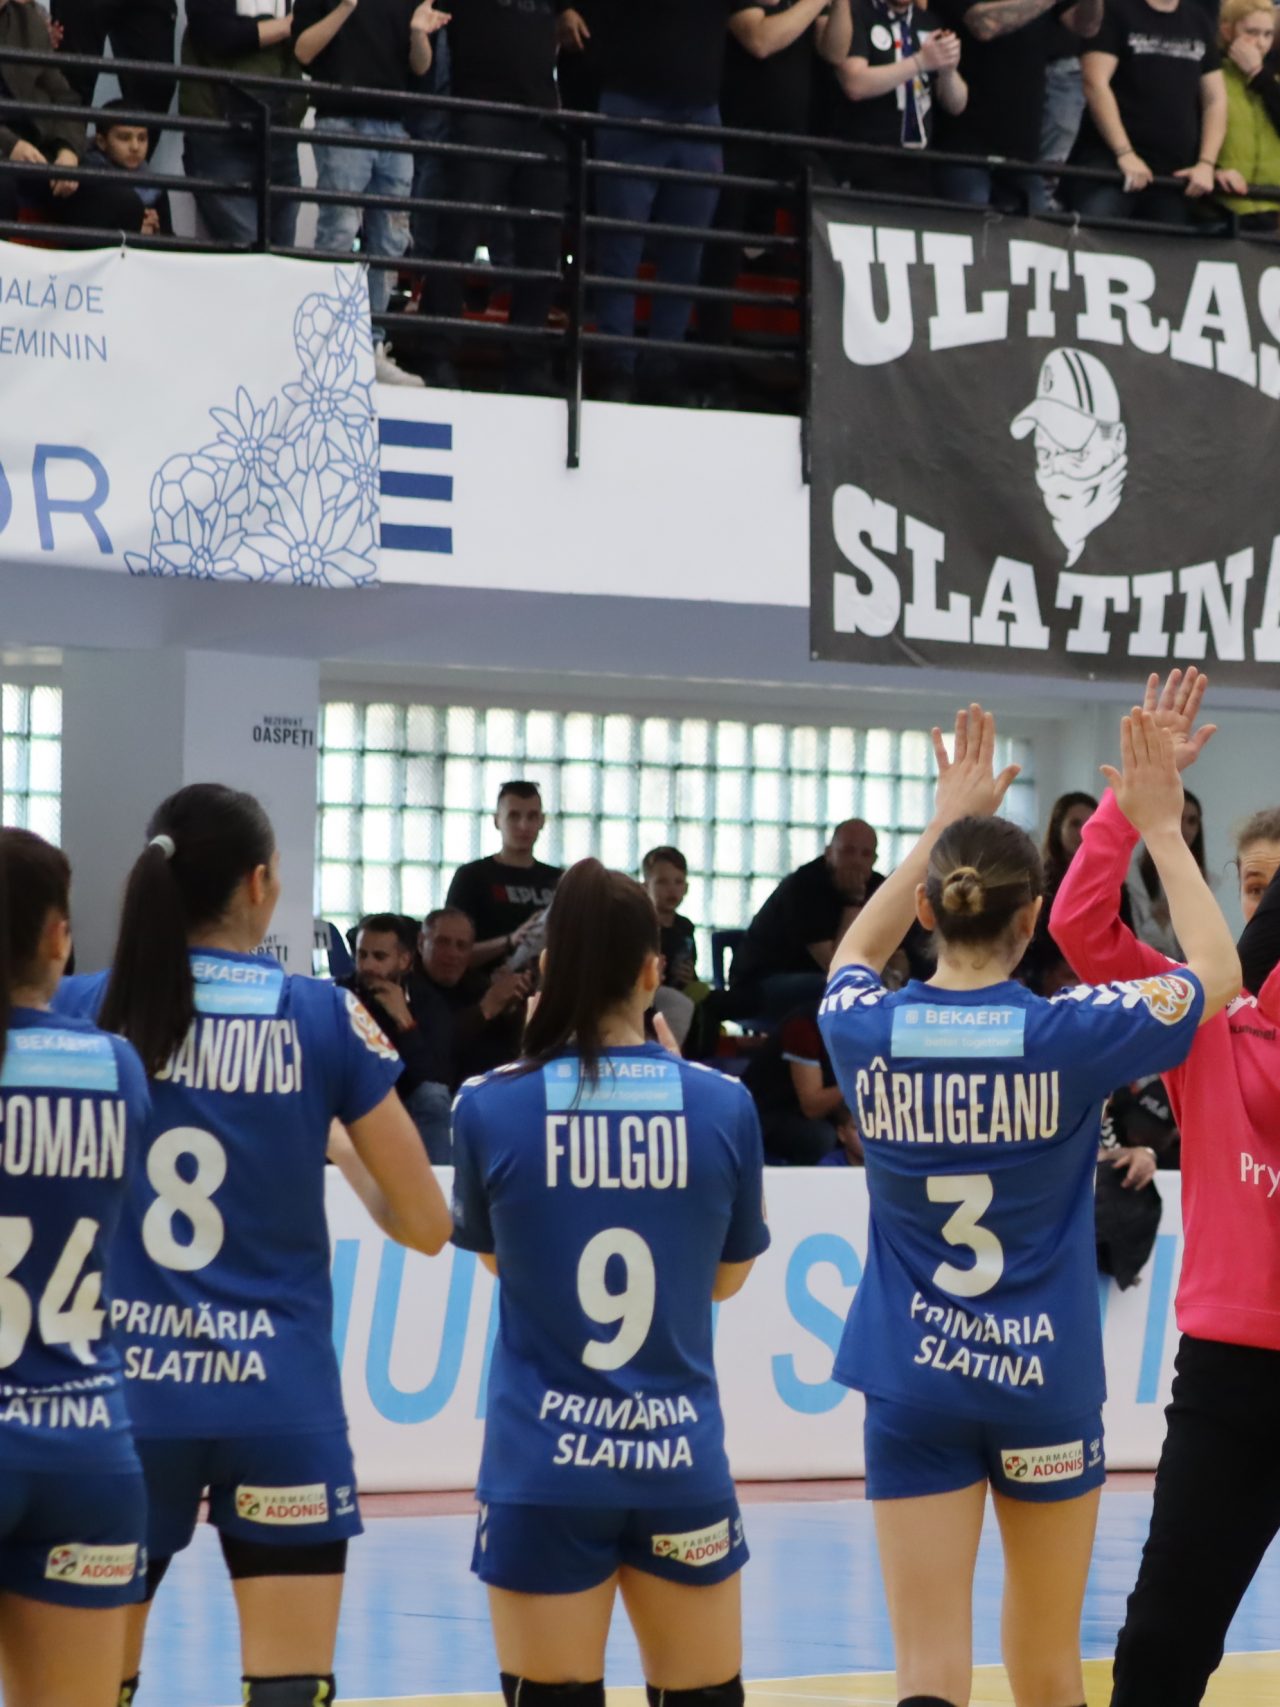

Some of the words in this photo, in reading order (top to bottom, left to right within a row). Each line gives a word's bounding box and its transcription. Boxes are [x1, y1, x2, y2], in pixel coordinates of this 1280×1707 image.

[0, 274, 57, 310] ALĂ
[64, 283, 104, 314] DE
[0, 443, 114, 555] R
[191, 960, 271, 985] EKAERT
[925, 1009, 1013, 1026] BEKAERT
[855, 1056, 1060, 1145] CÂRLIGEANU
[0, 1094, 126, 1180] OMAN
[546, 1115, 688, 1189] FULGOI
[142, 1126, 228, 1272] 8
[926, 1174, 1004, 1298] 3
[110, 1299, 275, 1340] PRIMĂRIA
[577, 1227, 656, 1371] 9
[910, 1291, 1054, 1345] PRIMĂRIA
[124, 1345, 266, 1384] SLATINA
[914, 1335, 1044, 1387] SLATINA
[0, 1395, 112, 1430] ATINA
[539, 1390, 698, 1431] PRIMĂRIA
[553, 1433, 694, 1470] SLATINA
[1033, 1457, 1083, 1476] ADONIS
[265, 1502, 327, 1518] ADONIS
